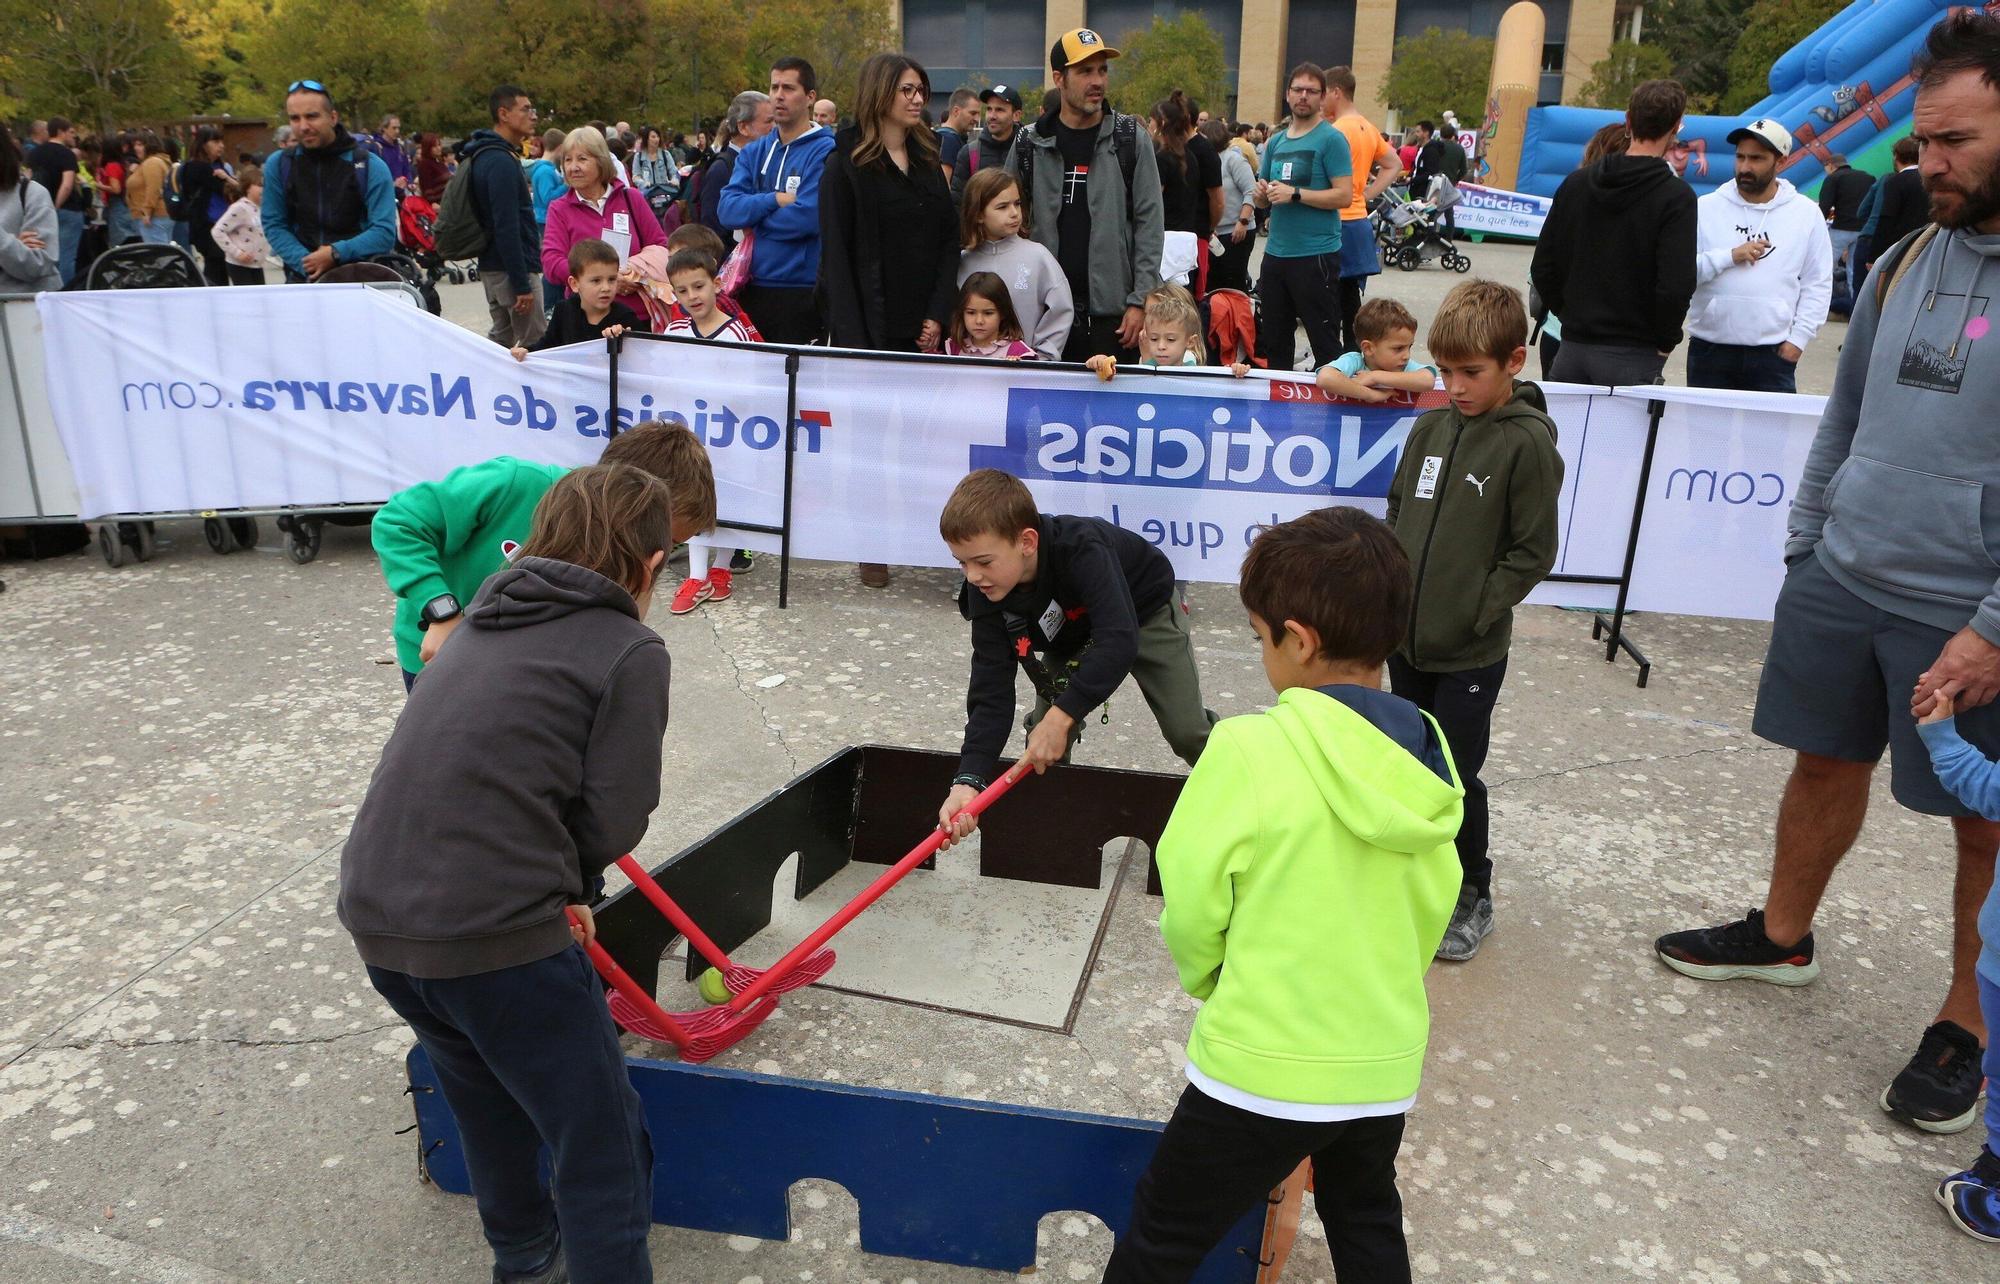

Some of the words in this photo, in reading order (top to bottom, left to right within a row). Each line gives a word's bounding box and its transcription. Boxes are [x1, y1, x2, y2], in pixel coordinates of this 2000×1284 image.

[1462, 191, 1533, 213] Noticias
[1475, 213, 1485, 223] lo
[1487, 216, 1507, 226] que
[1509, 217, 1530, 228] lees
